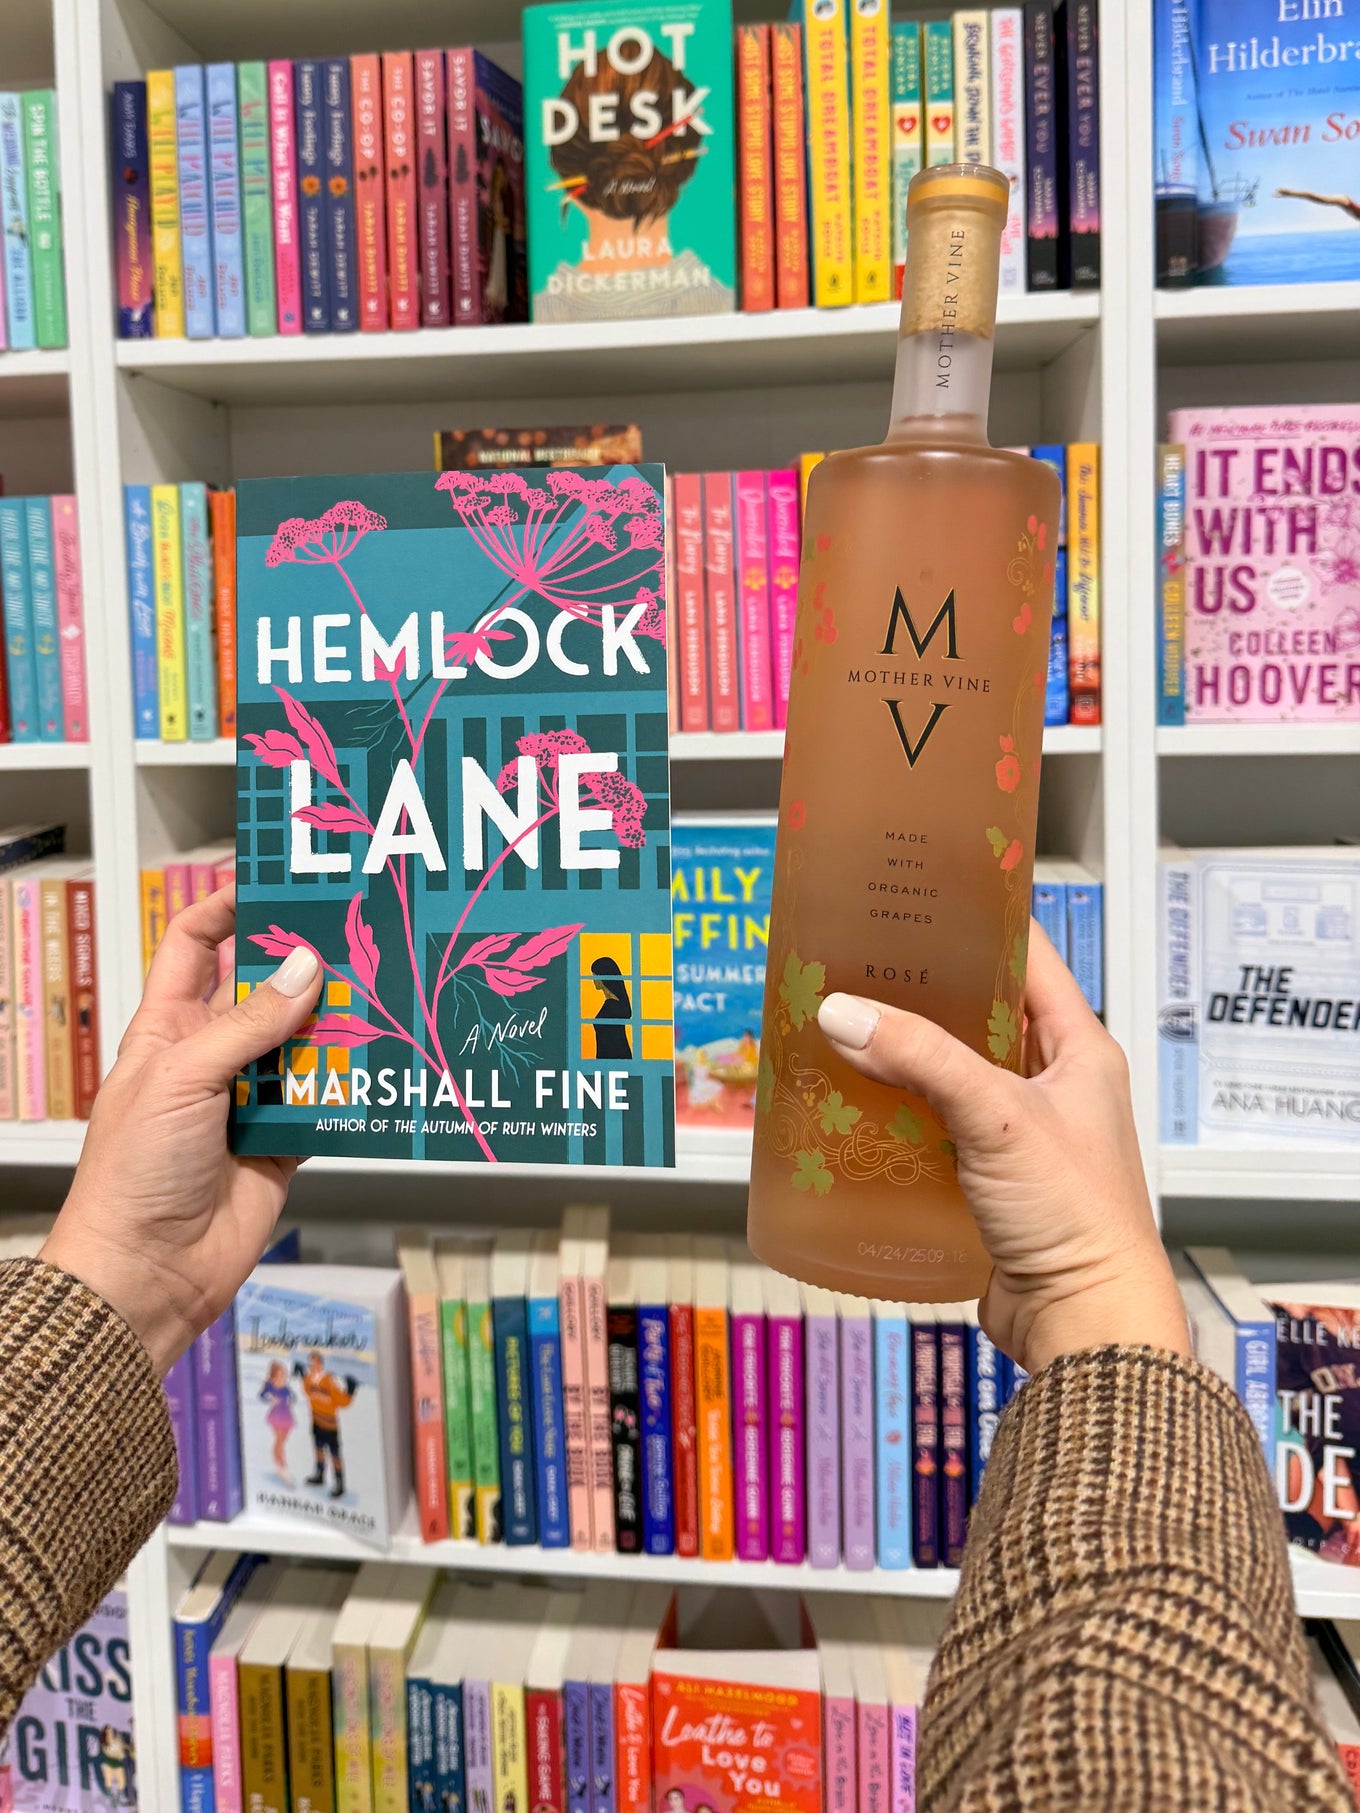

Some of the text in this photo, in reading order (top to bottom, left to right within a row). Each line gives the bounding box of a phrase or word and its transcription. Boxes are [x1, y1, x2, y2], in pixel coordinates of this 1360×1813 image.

[1278, 0, 1344, 22] Elin
[557, 23, 695, 79] HOT
[1171, 8, 1188, 106] Hilderbrand
[1208, 33, 1360, 74] Hilderbra
[274, 73, 288, 104] Call
[421, 59, 437, 136] SAVOR IT
[454, 56, 468, 132] SAVOR IT
[966, 23, 982, 146] BRINGING DOWN THE
[1034, 13, 1050, 154] NEVER EVER YOU
[1077, 5, 1092, 147] NEVER EVER YOU
[275, 108, 288, 121] It
[359, 70, 373, 158] THE CO-OP
[392, 68, 405, 157] THE CO-OP
[542, 86, 713, 146] DESK
[818, 29, 838, 203] TOTAL DREAMBOAT
[862, 26, 880, 199] TOTAL DREAMBOAT
[1224, 120, 1311, 150] Swan
[29, 104, 52, 220] SPIN THE BOTTLE
[276, 127, 289, 167] What
[747, 153, 763, 179] LOVE
[781, 153, 798, 179] LOVE
[1169, 115, 1184, 181] Swan Song
[277, 170, 290, 199] You
[604, 176, 656, 195] A Novel
[747, 186, 764, 222] STORY
[782, 186, 799, 221] STORY
[279, 204, 290, 244] Want
[582, 236, 673, 262] LAURA
[548, 267, 711, 295] DICKERMAN
[936, 230, 964, 388] MOTHER VINE
[1195, 449, 1238, 498] IT
[1164, 454, 1180, 546] HEART BONES
[678, 505, 702, 575] The Nanny
[708, 505, 732, 575] The Nanny
[1194, 507, 1317, 555] WITH
[1194, 565, 1257, 615] US
[257, 603, 651, 684] HEMLOCK
[685, 590, 700, 695] LANA FERGUSON
[715, 590, 729, 695] LANA FERGUSON
[874, 584, 966, 661] M
[1163, 581, 1180, 696] COLLEEN HOOVER
[1228, 630, 1337, 656] COLLEEN
[848, 669, 991, 693] MOTHER VINE
[1195, 663, 1360, 707] HOOVER
[880, 698, 953, 771] V
[289, 752, 621, 873] LANE
[884, 831, 929, 844] MADE
[671, 867, 761, 902] MILY
[887, 857, 924, 870] WITH
[868, 882, 938, 898] ORGANIC
[44, 892, 62, 982] IN THE WEEDS
[75, 891, 91, 986] MIXED SIGNALS
[673, 914, 768, 949] FFIN
[870, 908, 933, 924] GRAPES
[1168, 871, 1191, 997] THE DEFENDER
[677, 965, 766, 985] SUMMER
[866, 964, 929, 984] ROSÉ
[1238, 965, 1294, 994] THE
[673, 992, 728, 1012] PACT
[459, 1007, 548, 1055] A Novel
[286, 1067, 631, 1110] MARSHALL FINE
[1212, 1089, 1360, 1122] ANA HUANG
[316, 1118, 598, 1137] AUTHOR OF THE AUTUMN OF RUTH WINTERS
[1276, 1318, 1328, 1346] ELLE
[1245, 1340, 1269, 1376] GIRL
[507, 1336, 523, 1454] PICTURES OF YOU
[978, 1379, 995, 1411] on
[1277, 1389, 1344, 1440] THE
[564, 1385, 585, 1486] BY THE BOOK
[593, 1386, 612, 1488] BY THE BOOK
[257, 1491, 376, 1529] HANNAH GRACE
[41, 1633, 131, 1702] ISS
[66, 1698, 96, 1722] THE
[677, 1682, 798, 1706] ALI HAZELWOOD
[218, 1671, 233, 1787] MAGNOLIA PARKS
[661, 1705, 778, 1747] Loathe to
[17, 1716, 110, 1797] GIR
[628, 1746, 640, 1801] Love You
[702, 1745, 767, 1772] Love
[728, 1769, 780, 1797] You
